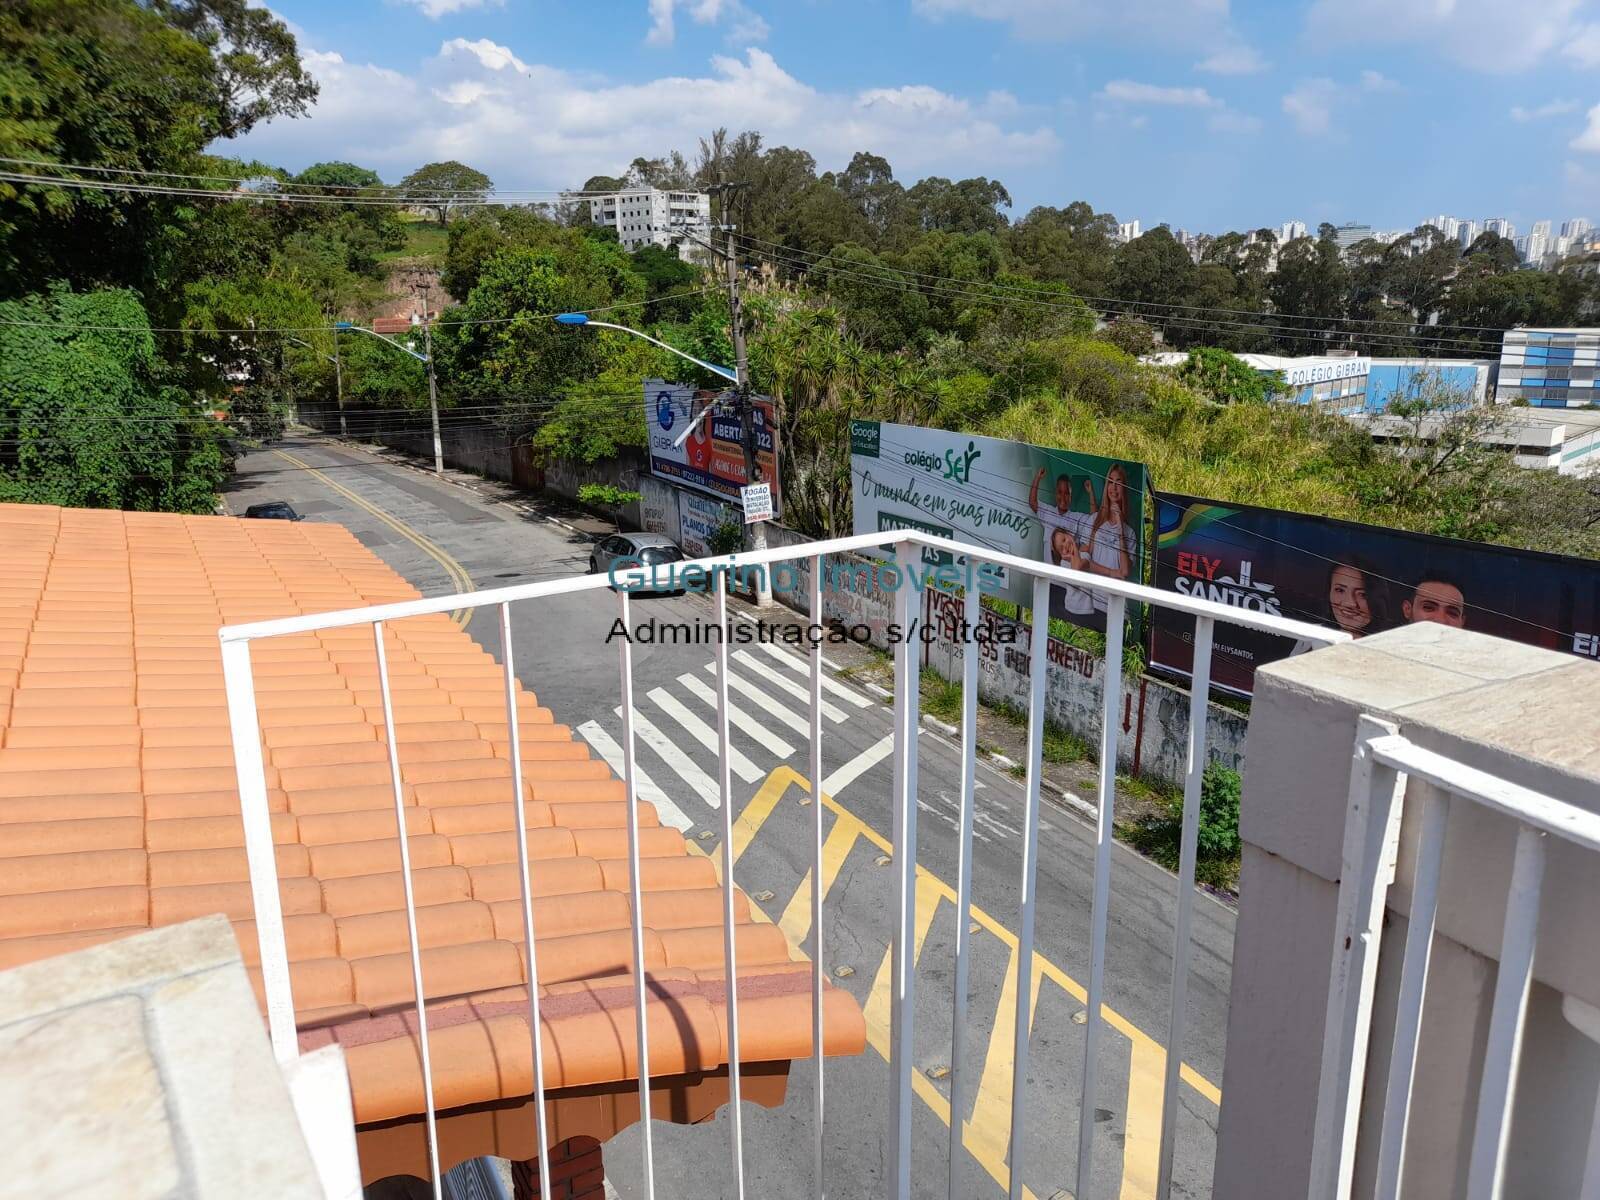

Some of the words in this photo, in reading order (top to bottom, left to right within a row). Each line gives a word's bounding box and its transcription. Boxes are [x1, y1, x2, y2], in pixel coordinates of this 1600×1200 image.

[1336, 361, 1368, 377] GIBRAN
[852, 423, 878, 441] Google
[904, 450, 942, 472] colégio
[874, 478, 920, 507] mundo
[923, 492, 946, 511] em
[949, 500, 984, 527] suas
[987, 508, 1032, 539] mãos
[682, 515, 705, 534] PLANOS
[1177, 551, 1222, 581] ELY
